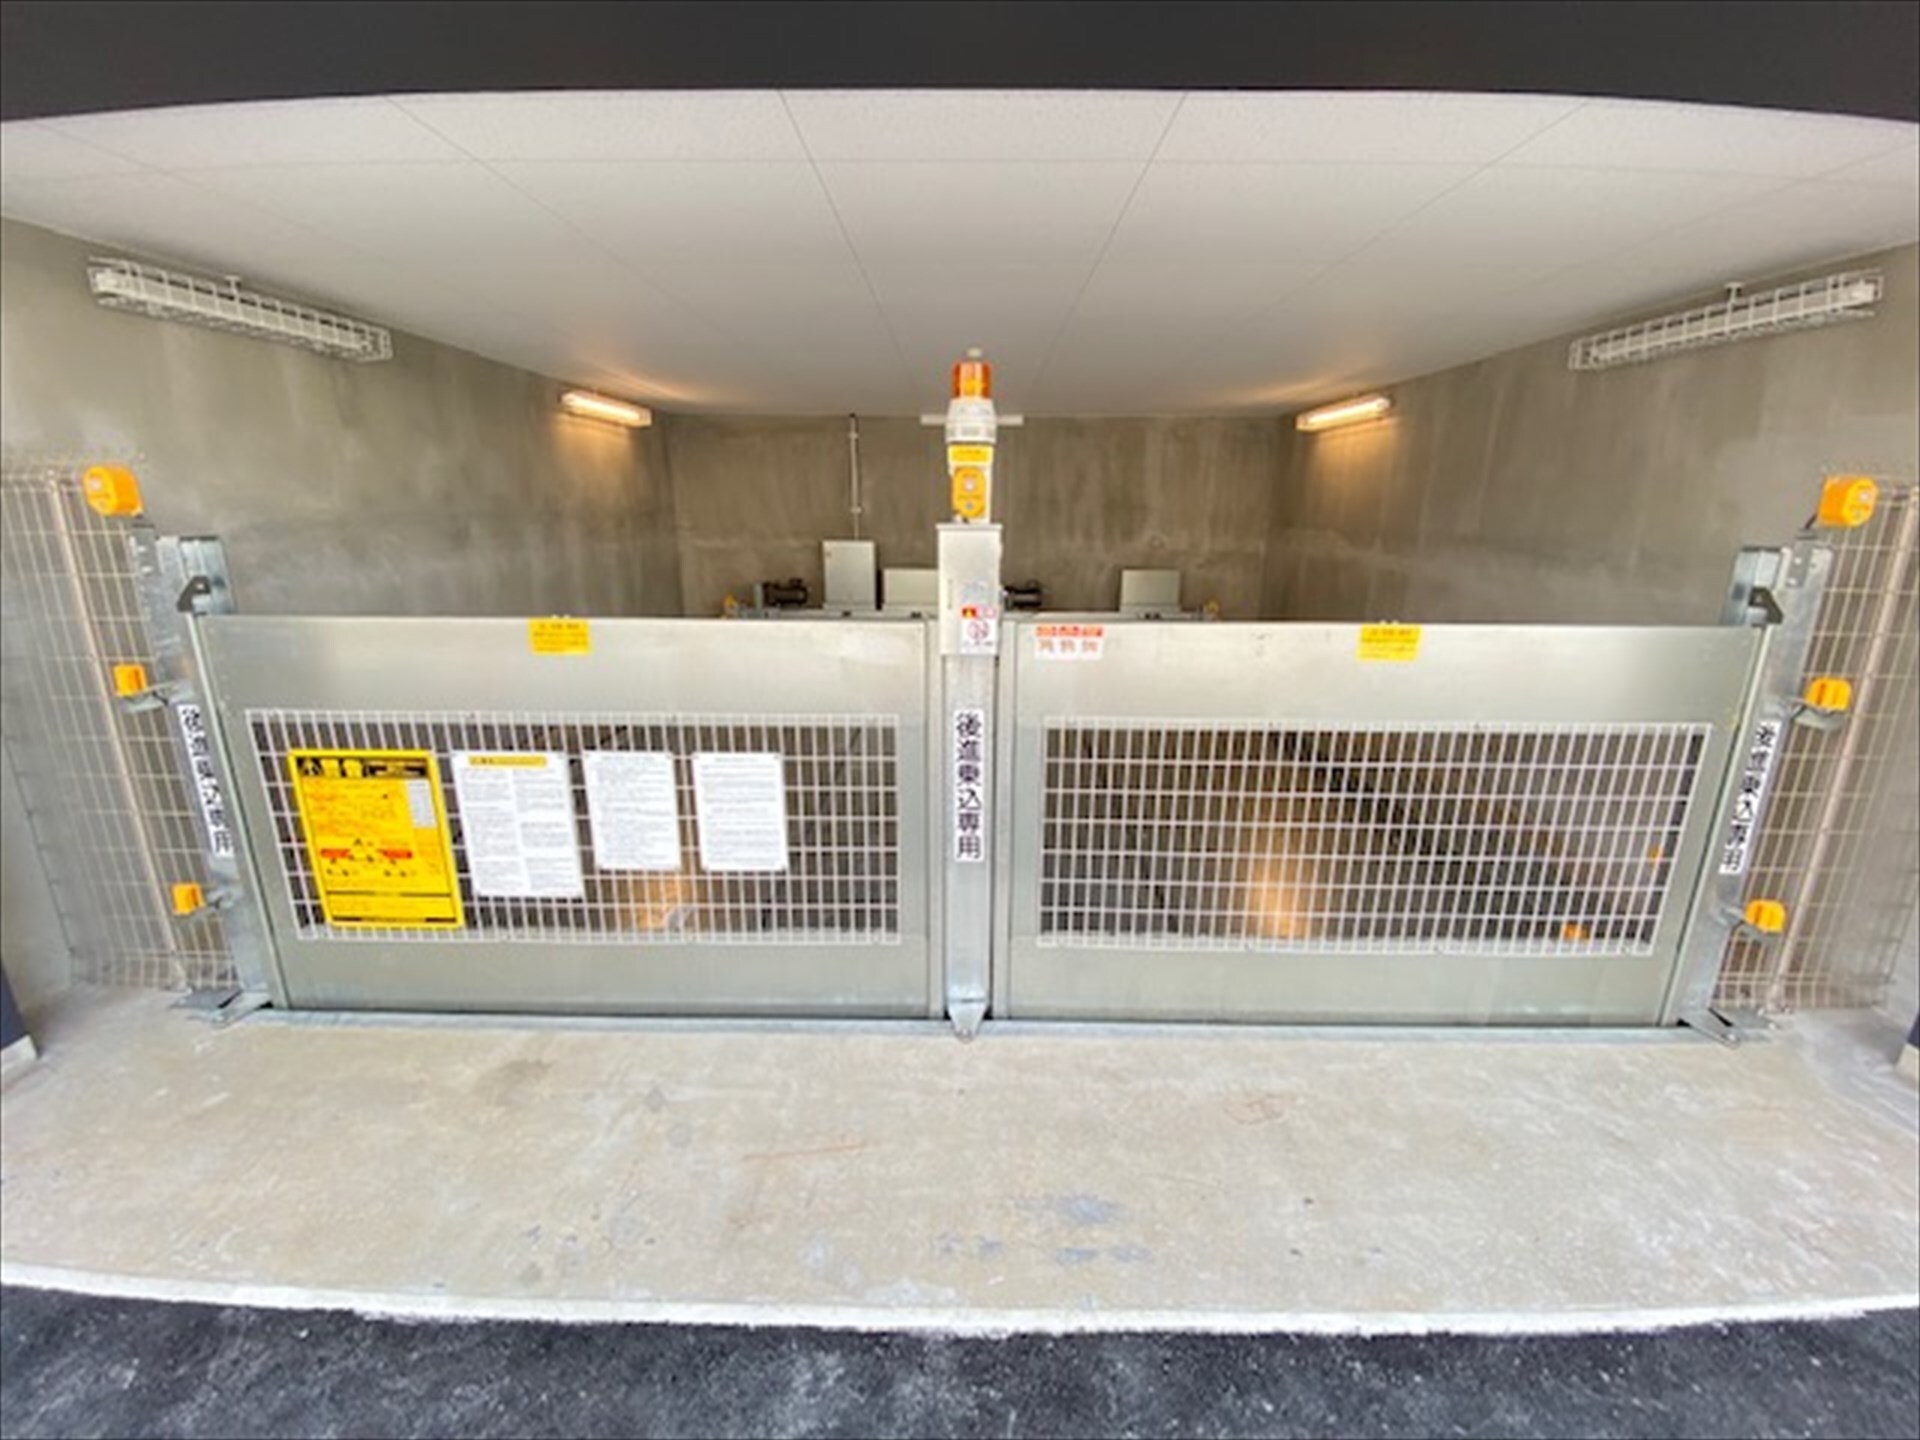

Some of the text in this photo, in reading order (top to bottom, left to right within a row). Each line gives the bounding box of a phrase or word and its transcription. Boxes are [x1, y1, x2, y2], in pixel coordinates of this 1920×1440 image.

[956, 711, 982, 859] 後進乗込専用
